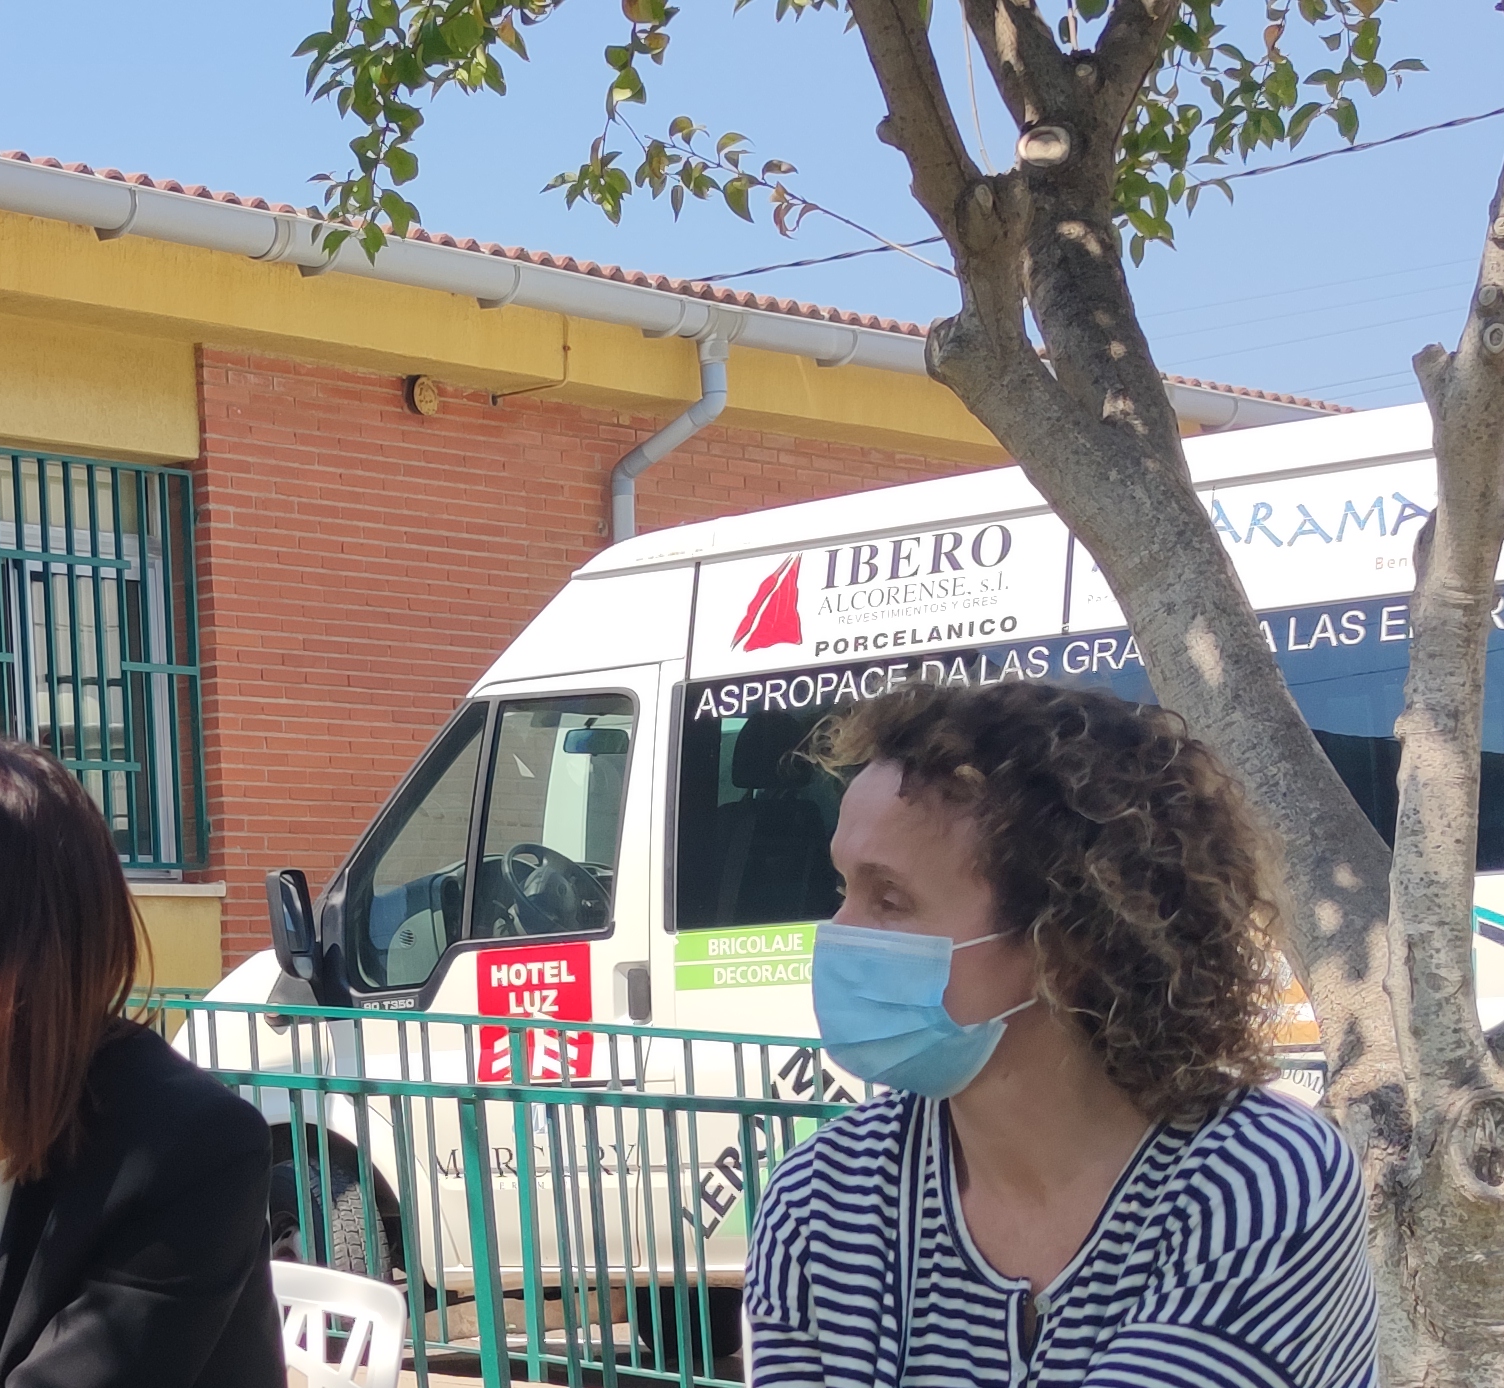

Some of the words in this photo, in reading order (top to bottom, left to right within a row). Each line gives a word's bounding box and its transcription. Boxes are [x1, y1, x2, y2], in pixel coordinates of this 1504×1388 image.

[821, 524, 1012, 590] IBERO
[838, 602, 948, 625] REVESTIMIENTOS
[950, 601, 959, 612] Y
[962, 595, 998, 610] GRES
[815, 616, 1018, 657] PORCELANICO
[980, 646, 1050, 685] LAS
[1288, 609, 1366, 652] LAS
[707, 933, 803, 956] BRICOLAJE
[490, 960, 576, 989] HOTEL
[713, 963, 812, 985] DECORACI
[508, 989, 559, 1015] LUZ
